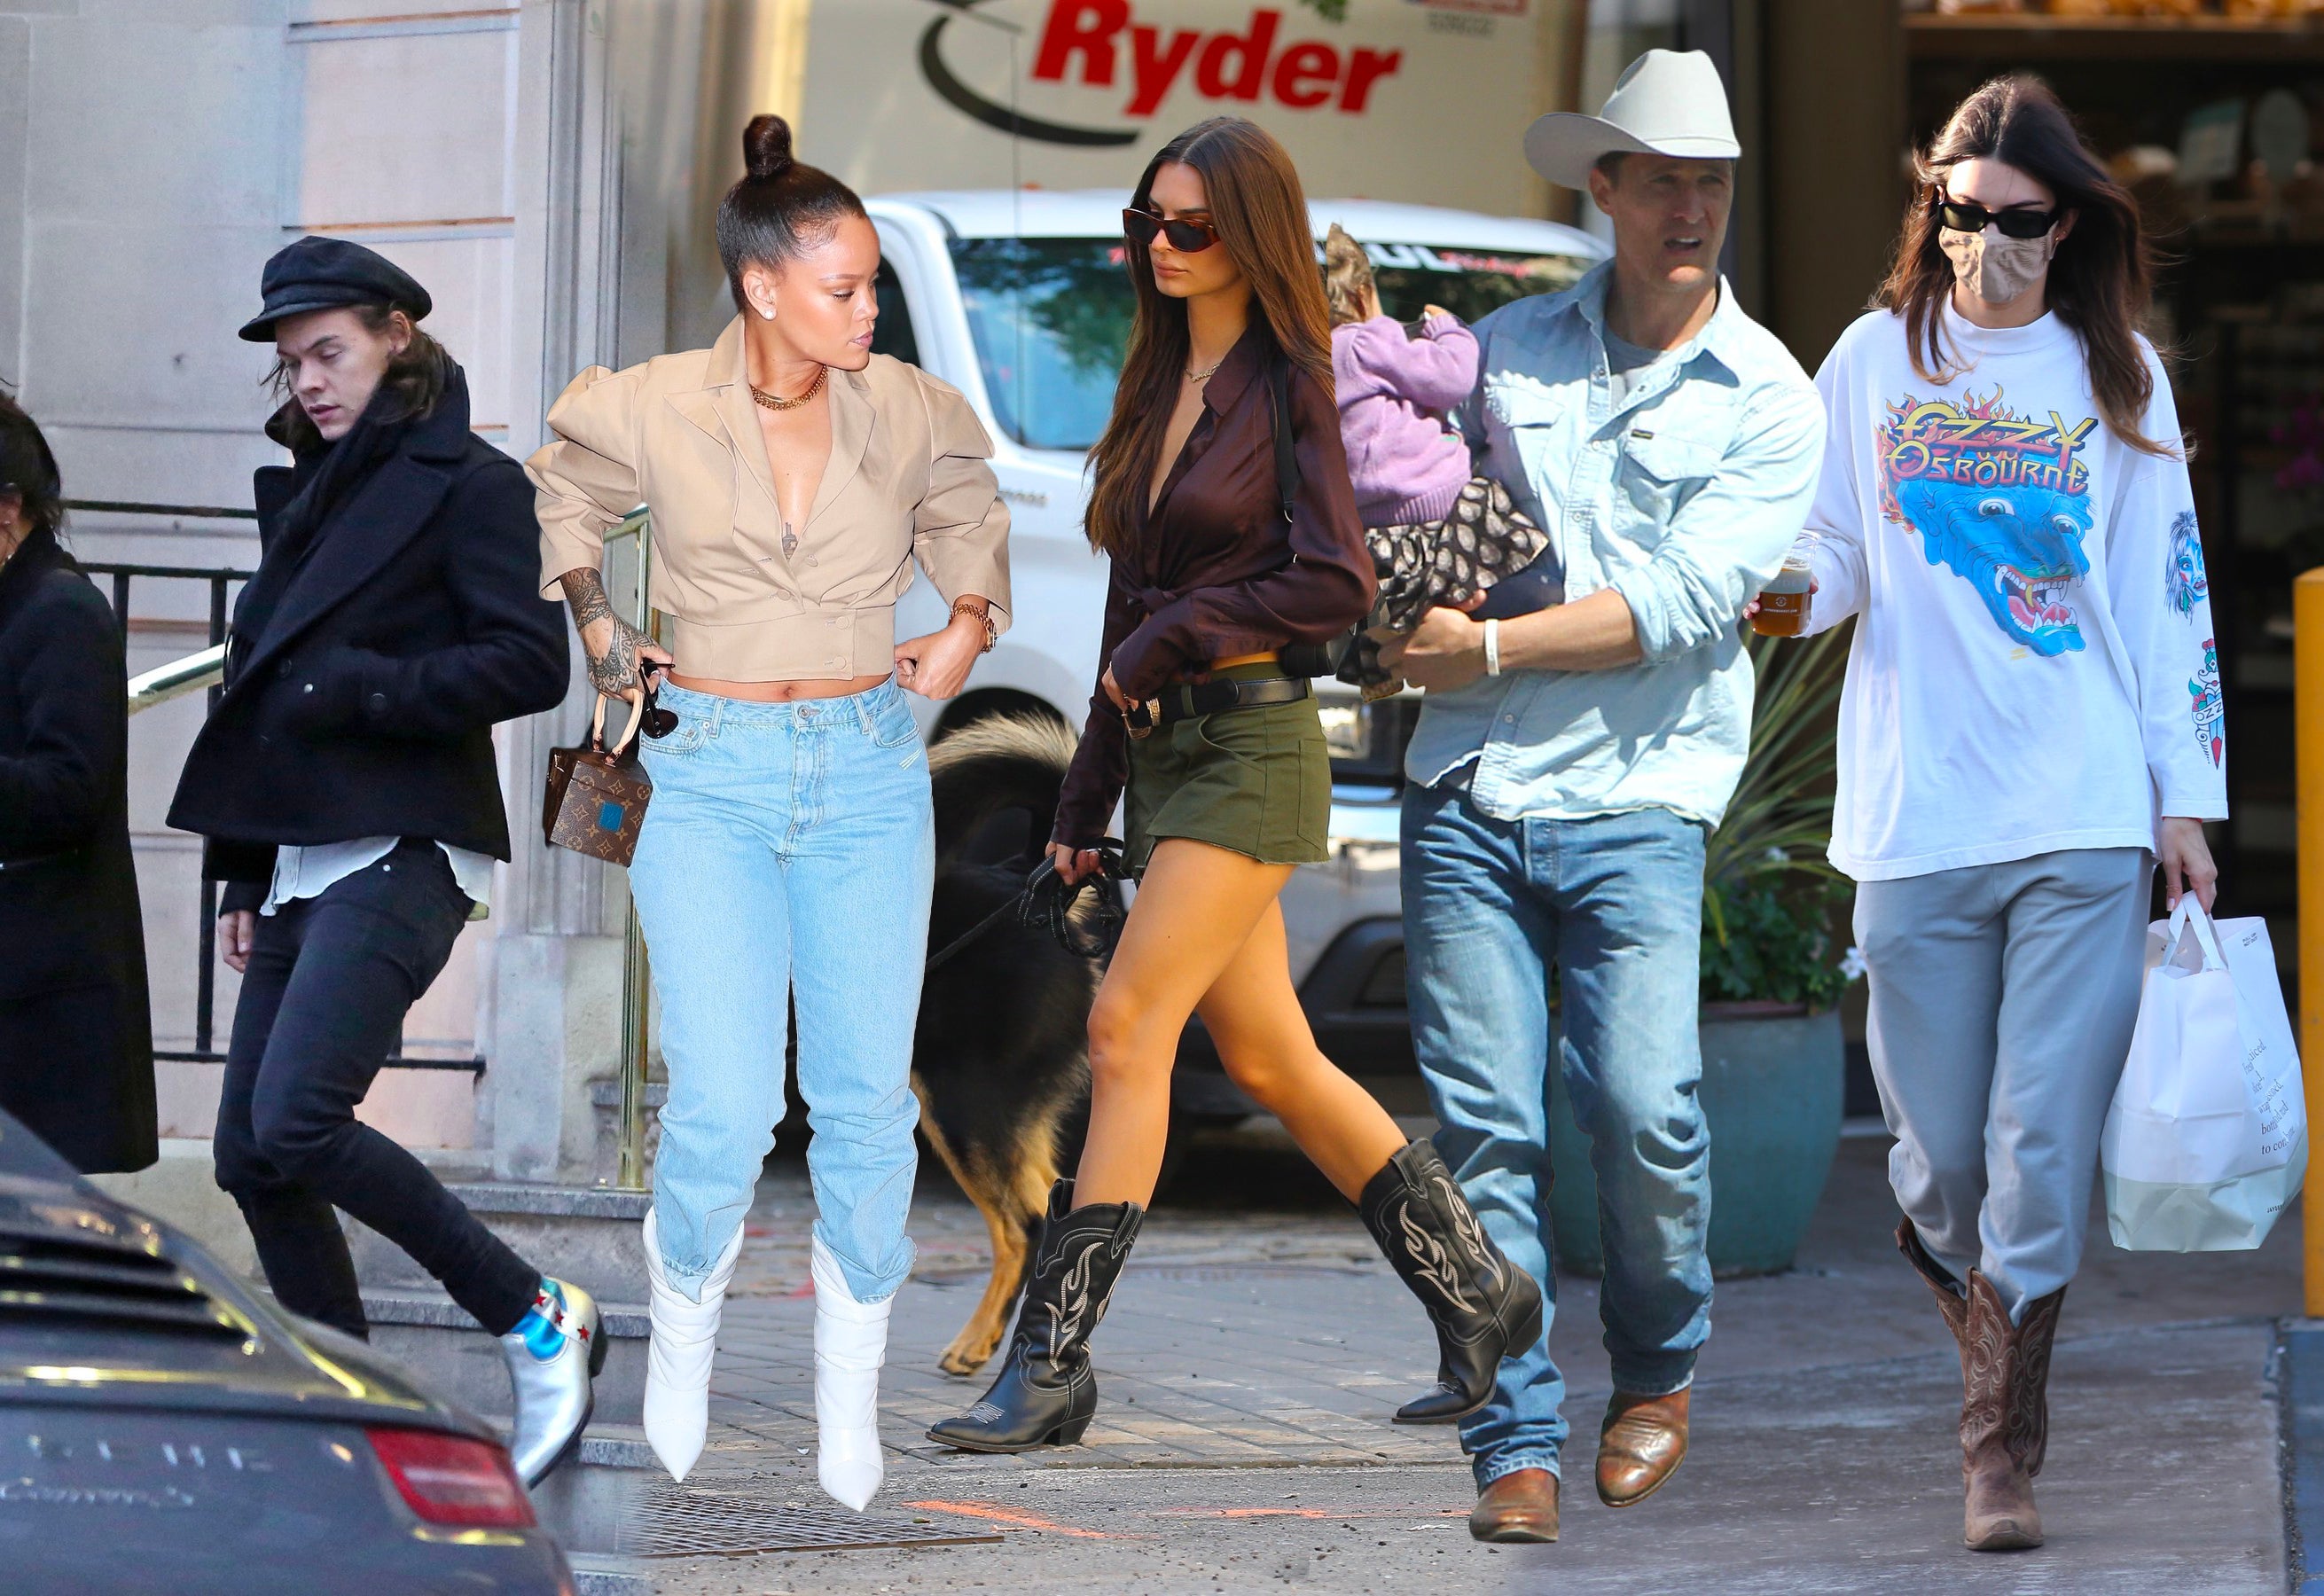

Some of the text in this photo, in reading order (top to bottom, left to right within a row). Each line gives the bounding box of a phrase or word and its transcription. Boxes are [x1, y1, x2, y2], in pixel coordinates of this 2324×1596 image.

[1032, 0, 1404, 117] Ryder
[1894, 402, 2099, 471] OZZY
[2195, 701, 2223, 722] OZZ
[2261, 1145, 2271, 1154] to
